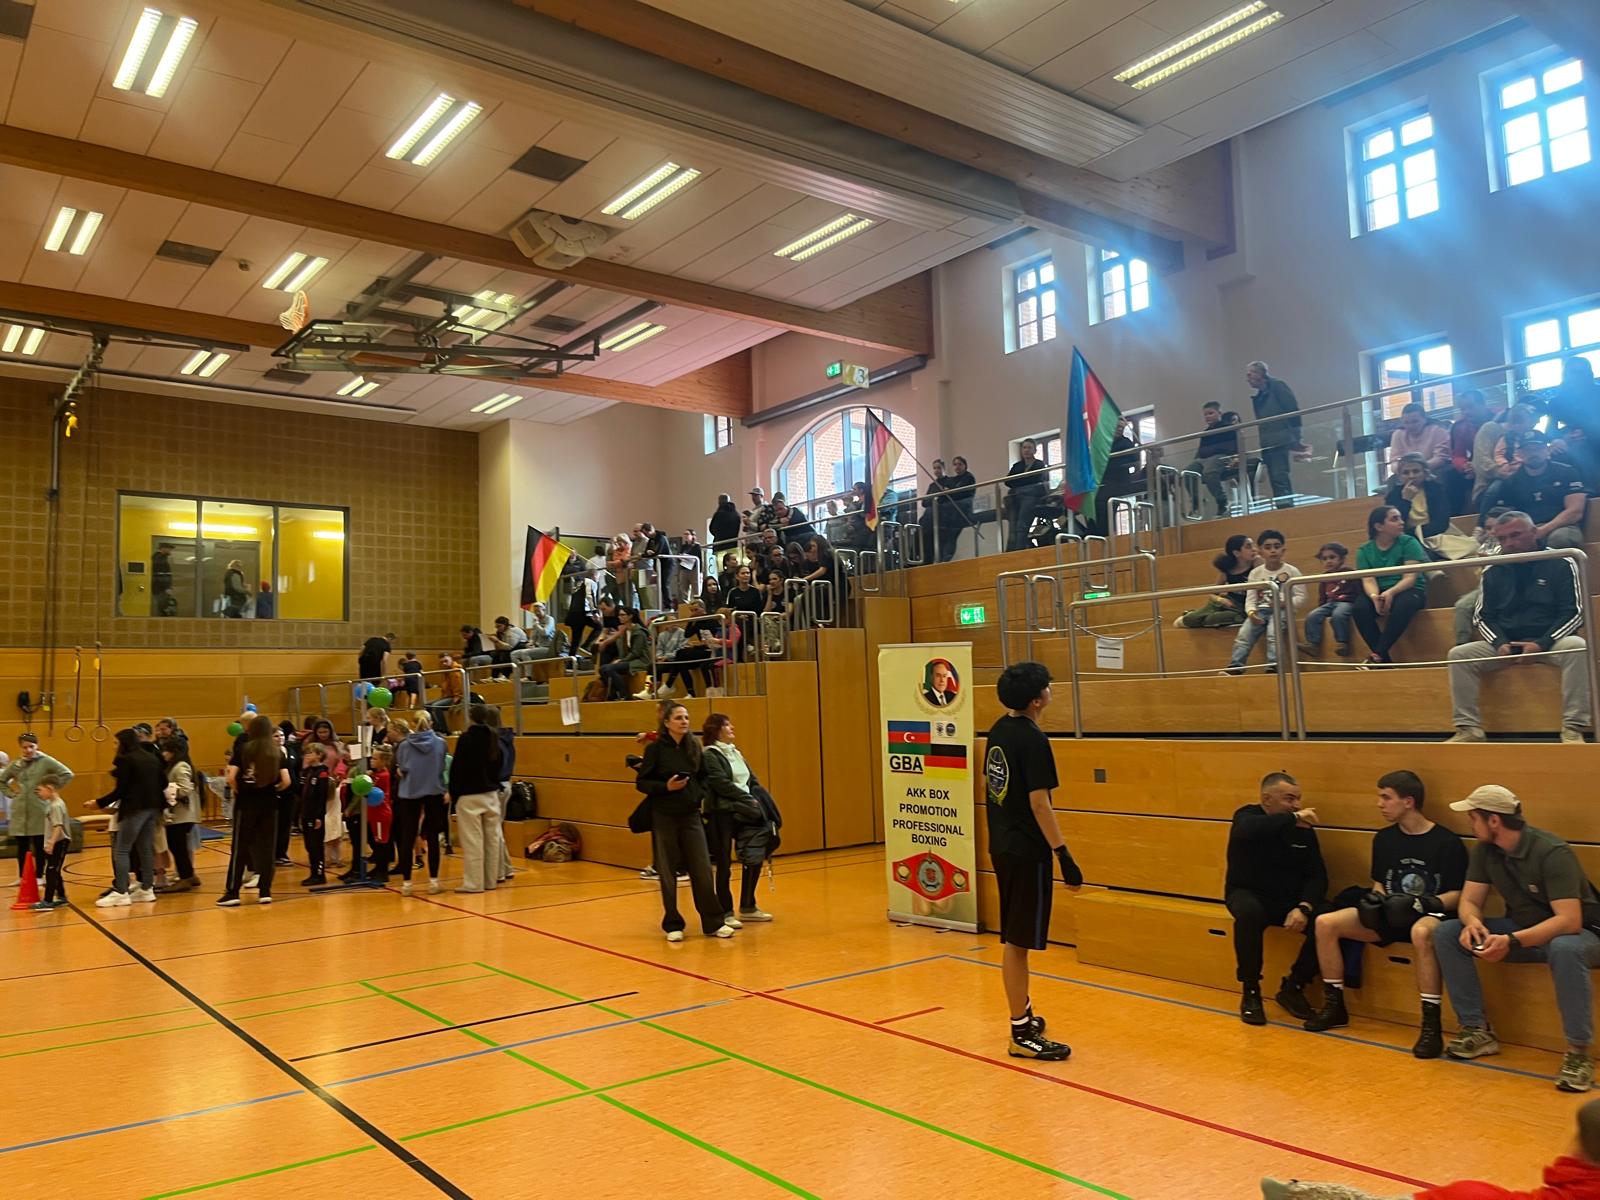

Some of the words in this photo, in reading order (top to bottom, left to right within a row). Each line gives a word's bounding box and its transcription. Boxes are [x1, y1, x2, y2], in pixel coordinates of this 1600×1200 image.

[858, 368, 865, 384] 3
[889, 755, 923, 771] GBA
[906, 787, 926, 798] AKK
[929, 788, 950, 800] BOX
[899, 803, 957, 817] PROMOTION
[892, 819, 964, 835] PROFESSIONAL
[911, 834, 947, 847] BOXING
